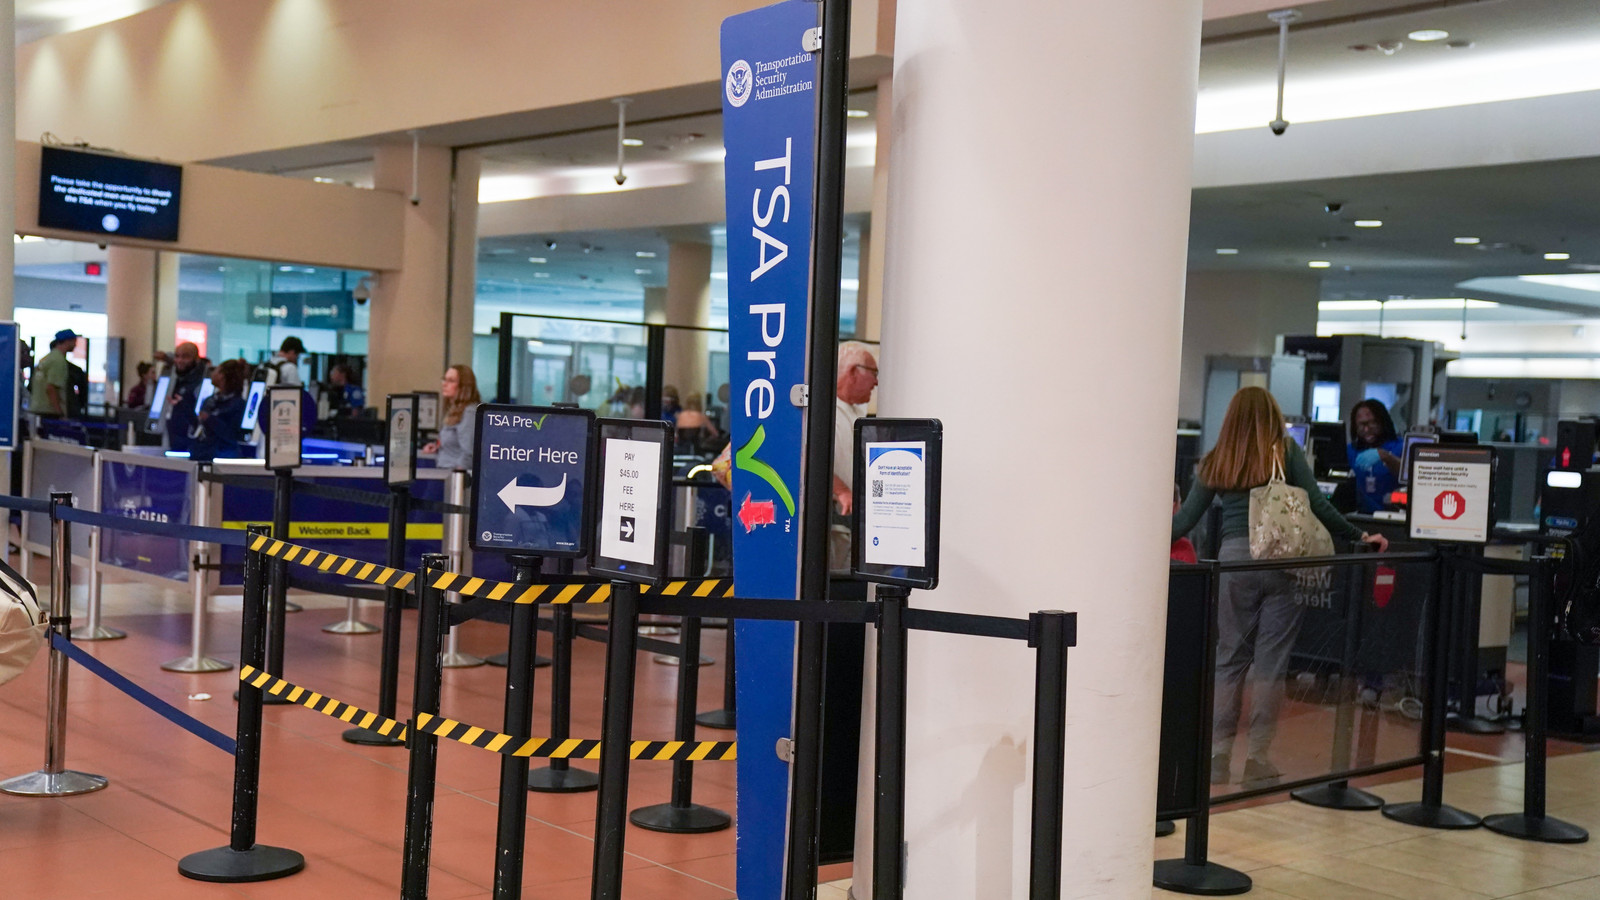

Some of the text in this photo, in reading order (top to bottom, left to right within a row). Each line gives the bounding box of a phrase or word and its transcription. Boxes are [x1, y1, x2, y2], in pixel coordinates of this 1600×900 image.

[755, 52, 812, 74] Transportation
[755, 72, 787, 87] Security
[755, 80, 812, 100] Administration
[750, 137, 792, 282] TSA
[745, 303, 786, 420] Pre
[488, 414, 533, 428] TSA Pre
[489, 444, 578, 464] Enter Here
[624, 452, 635, 461] PAY
[620, 468, 639, 479] $45.00
[623, 485, 634, 495] FEE
[619, 502, 635, 512] HERE
[299, 525, 371, 535] Welcome Back
